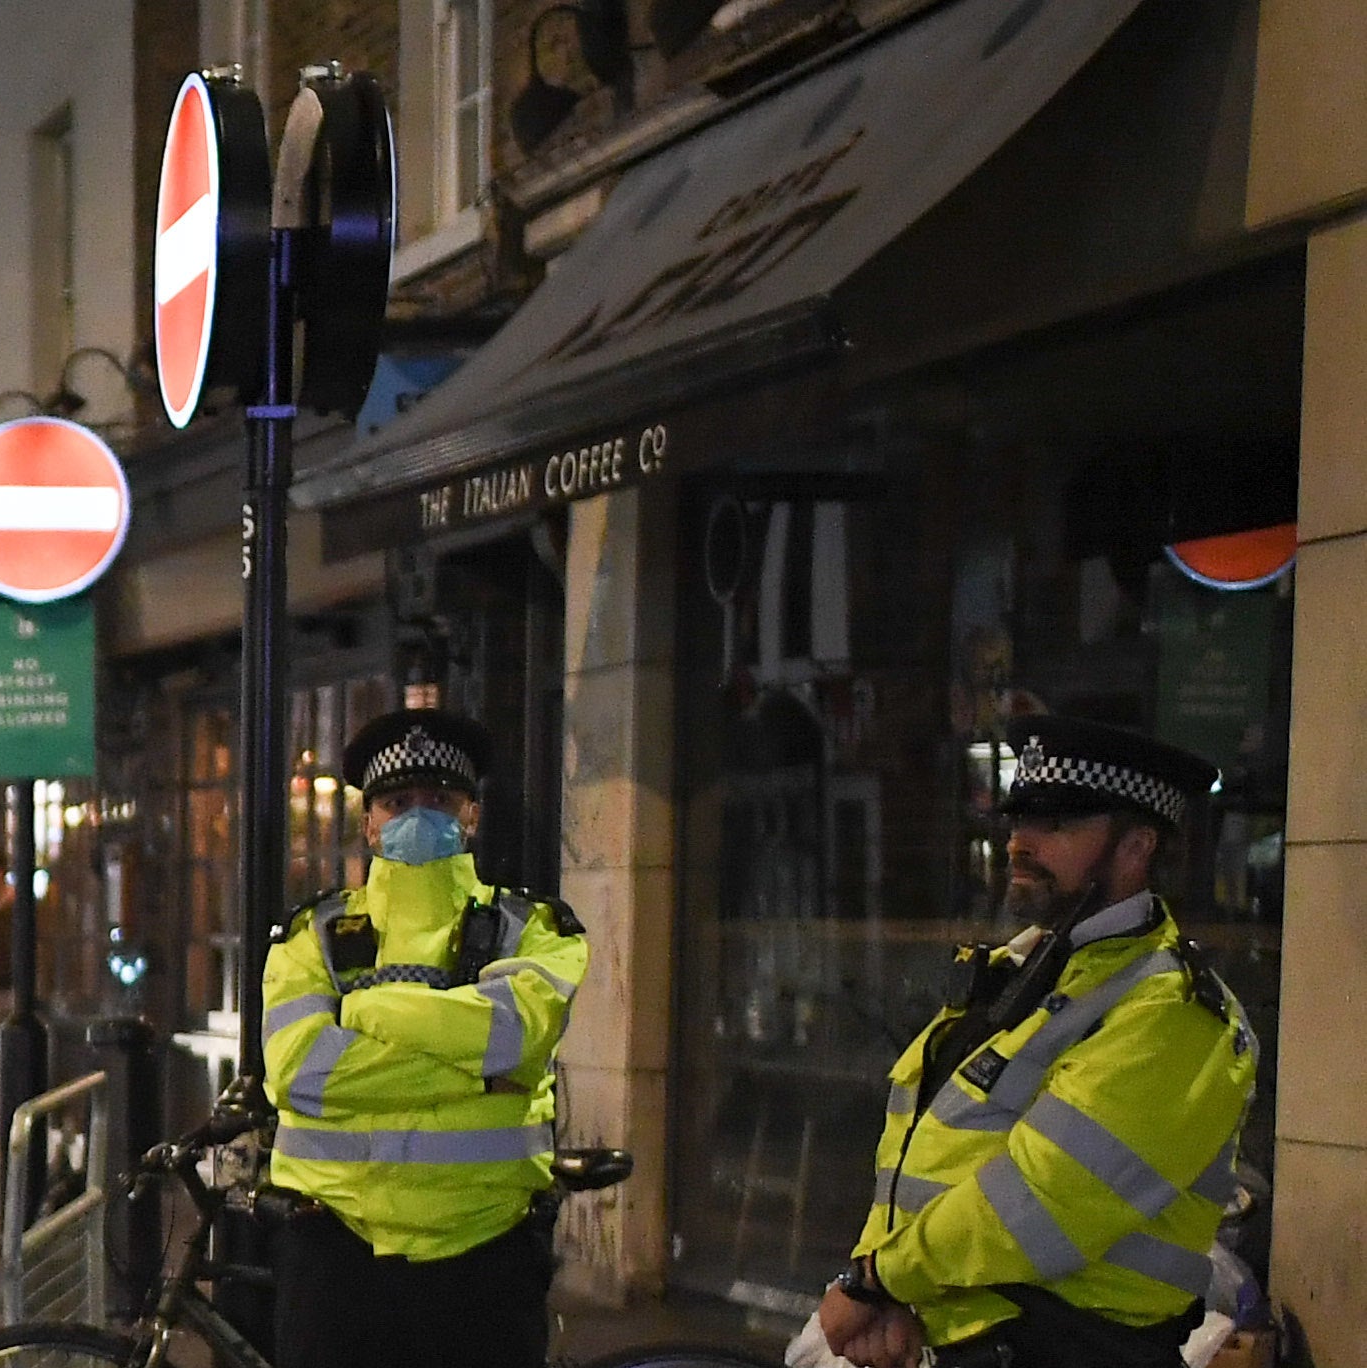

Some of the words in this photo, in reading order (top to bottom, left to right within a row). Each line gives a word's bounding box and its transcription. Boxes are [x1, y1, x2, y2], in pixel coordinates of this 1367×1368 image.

[420, 486, 452, 528] THE
[464, 463, 534, 517] ITALIAN
[544, 437, 625, 498] COFFEE
[13, 658, 40, 671] NO
